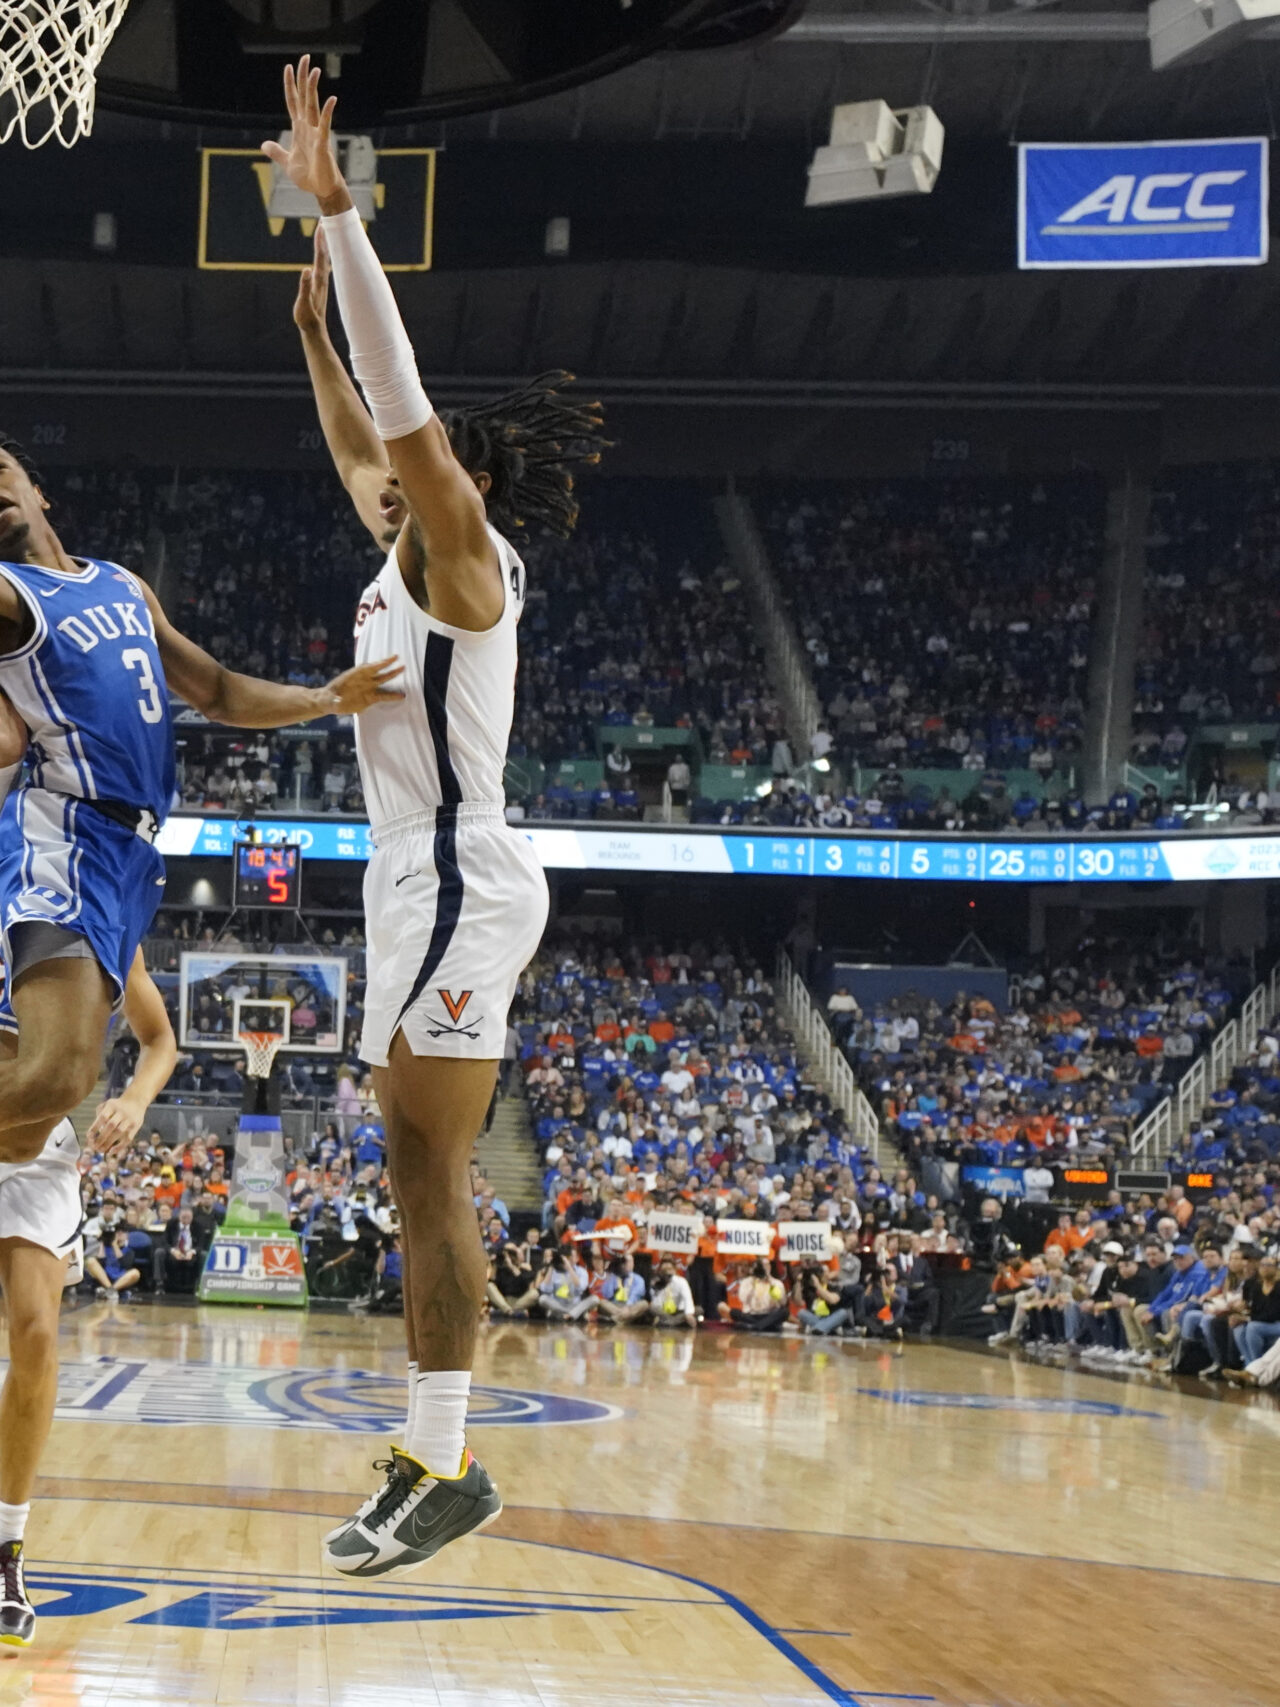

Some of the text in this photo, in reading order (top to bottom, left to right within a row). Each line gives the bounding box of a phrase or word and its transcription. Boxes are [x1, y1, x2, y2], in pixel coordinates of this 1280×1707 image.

[1056, 170, 1247, 223] ACC
[31, 424, 67, 446] 202
[298, 430, 322, 451] 20
[122, 647, 163, 724] 3
[266, 828, 314, 850] 2ND
[608, 840, 632, 850] TEAM
[671, 843, 695, 863] 16
[744, 843, 755, 868] 1
[794, 842, 805, 856] 4
[824, 845, 844, 871] 3
[879, 845, 891, 859] 4
[965, 848, 977, 861] 0
[1054, 848, 1066, 862] 0
[1142, 847, 1159, 861] 13
[796, 858, 803, 871] 1
[879, 859, 891, 874] 0
[910, 848, 930, 874] 5
[966, 863, 976, 877] 2
[989, 849, 1025, 876] 25
[1077, 849, 1114, 876] 30
[1144, 863, 1155, 877] 2
[1054, 863, 1066, 878] 0
[267, 869, 288, 903] 5
[655, 1223, 693, 1244] NOISE
[725, 1231, 763, 1246] NOISE
[786, 1233, 824, 1251] NOISE
[207, 1278, 301, 1292] CHAMPIONSHIP GAME
